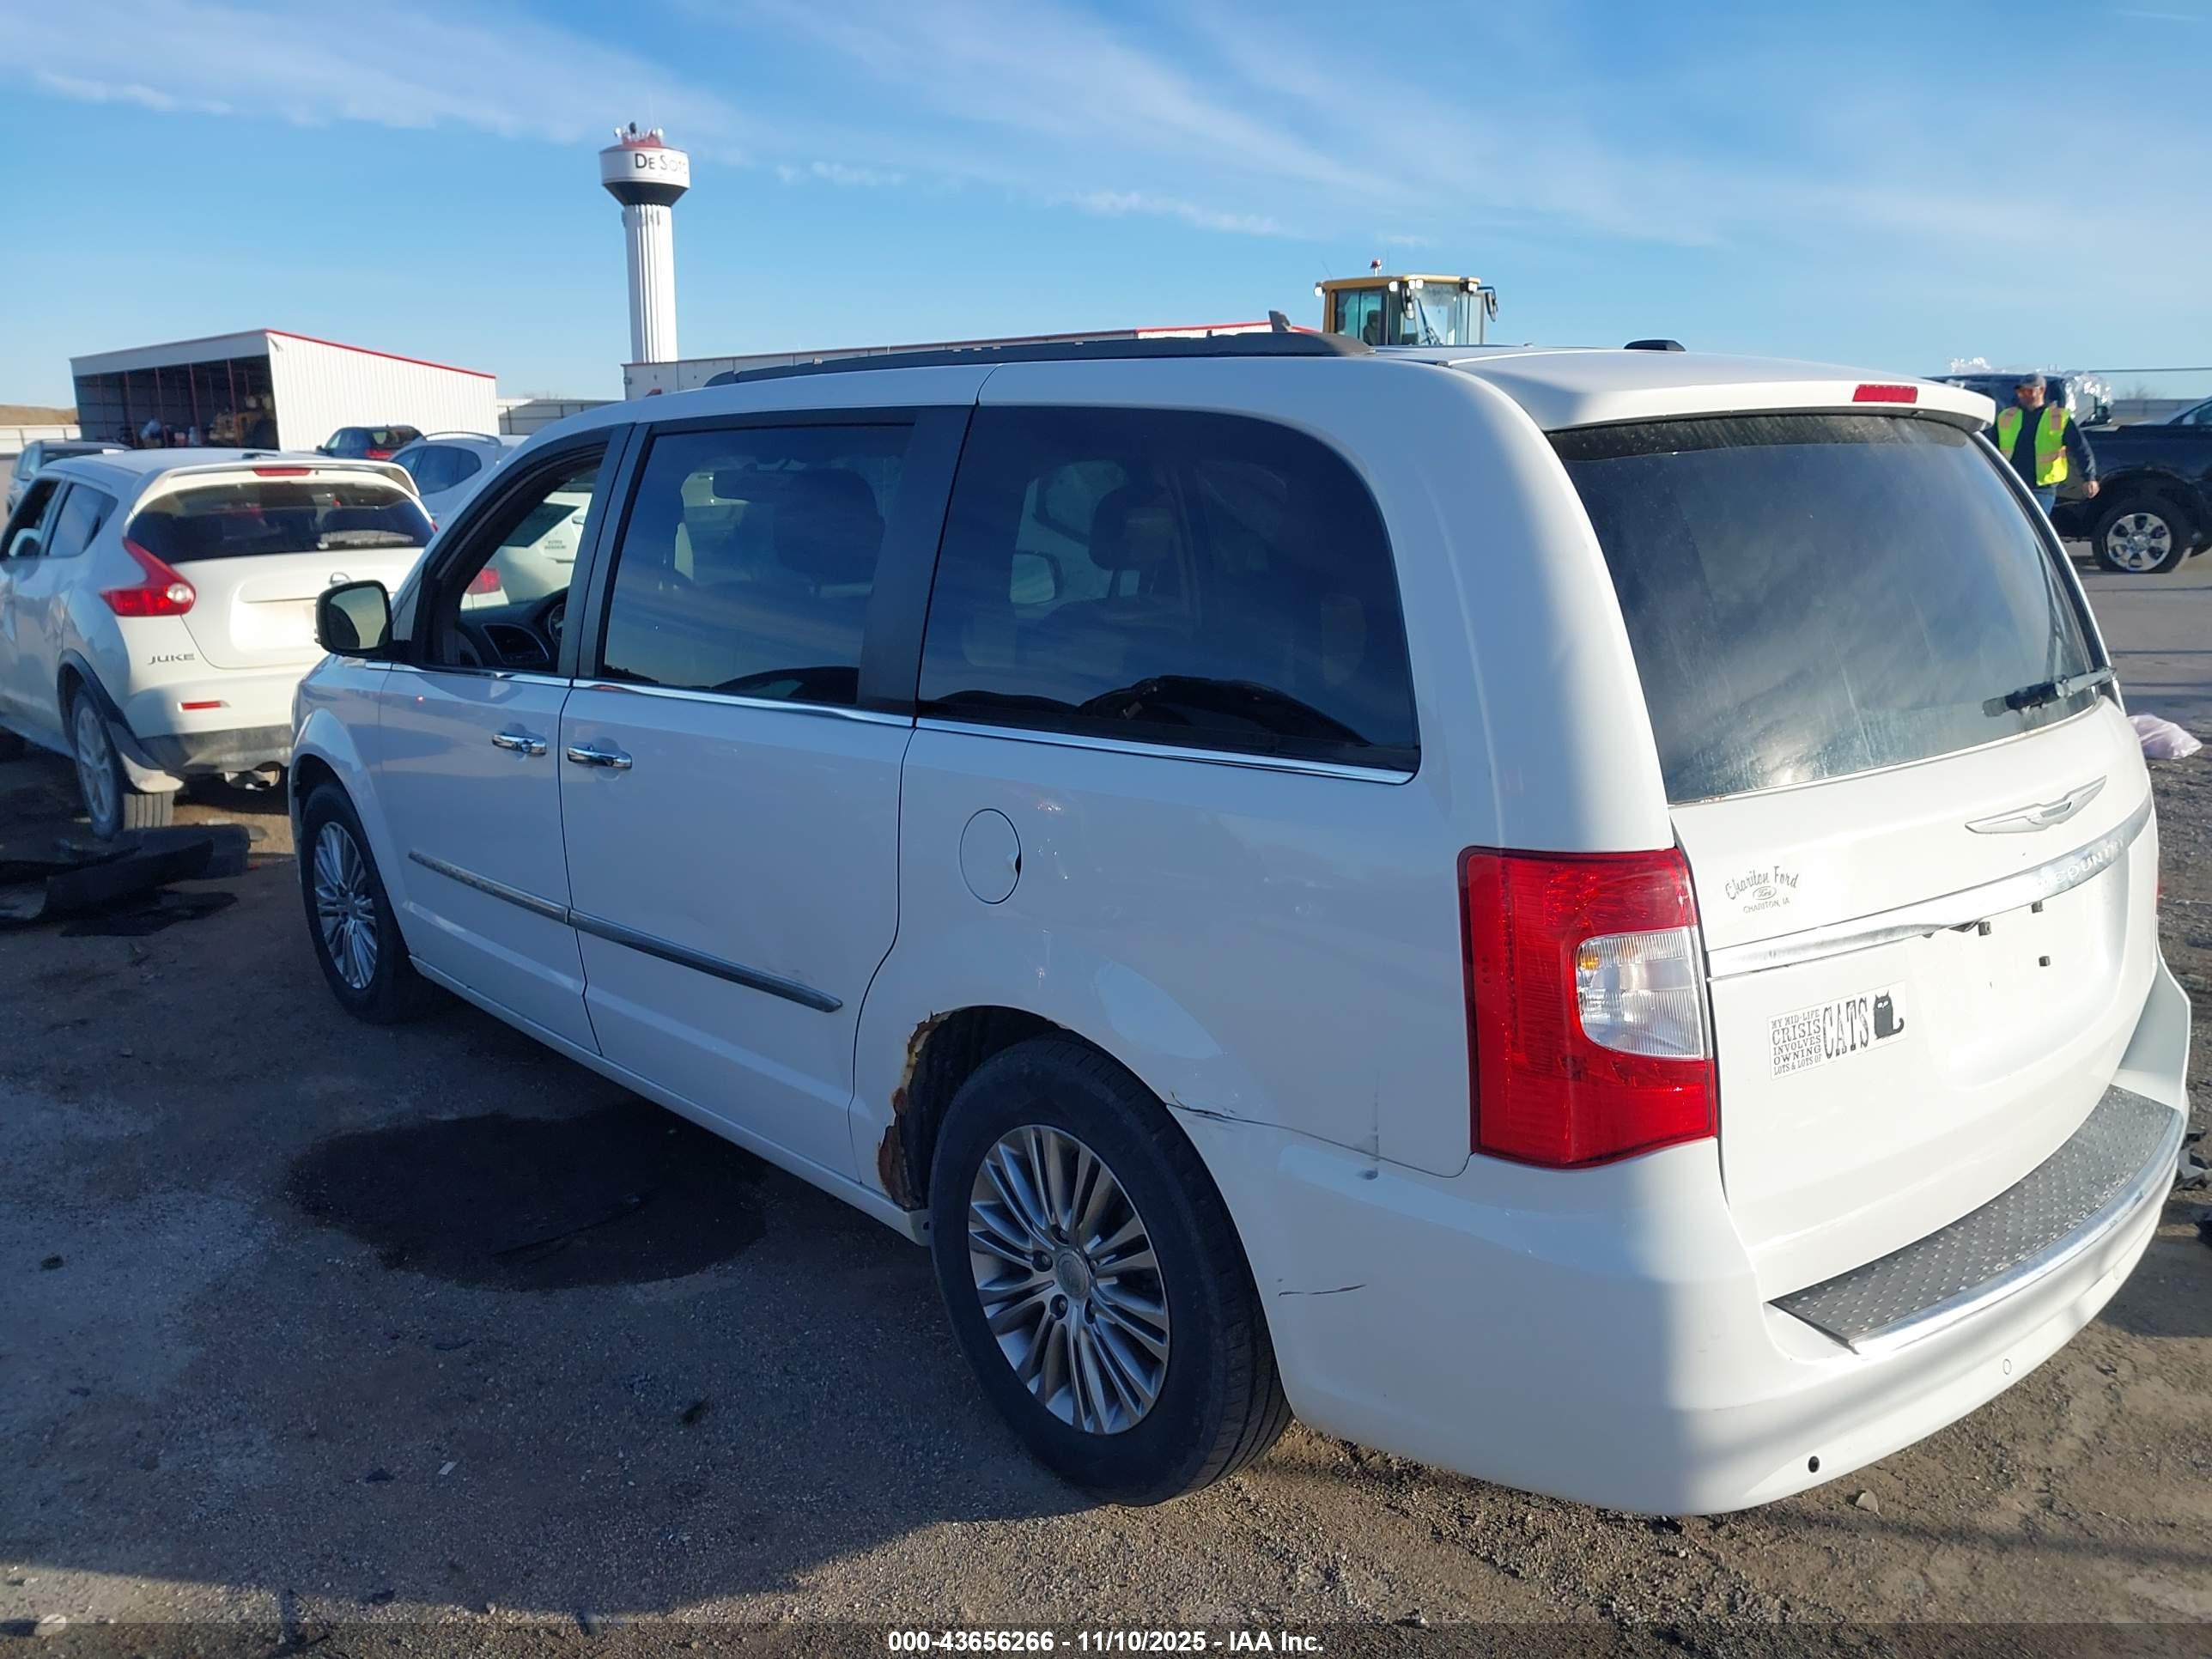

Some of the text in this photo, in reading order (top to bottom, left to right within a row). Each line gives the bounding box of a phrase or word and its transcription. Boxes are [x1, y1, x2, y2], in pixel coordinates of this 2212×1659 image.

[148, 653, 195, 665] JUKE
[1773, 866, 1800, 889] Ford
[1771, 1018, 1784, 1030] MY
[1771, 1018, 1821, 1046] CRISIS
[1822, 996, 1869, 1060] CATS
[1773, 1035, 1821, 1057] INVOLVES
[1773, 1044, 1822, 1066] OWNING
[1773, 1063, 1791, 1076] LOTS
[1797, 1056, 1814, 1070] LOTS
[1814, 1053, 1822, 1064] OF
